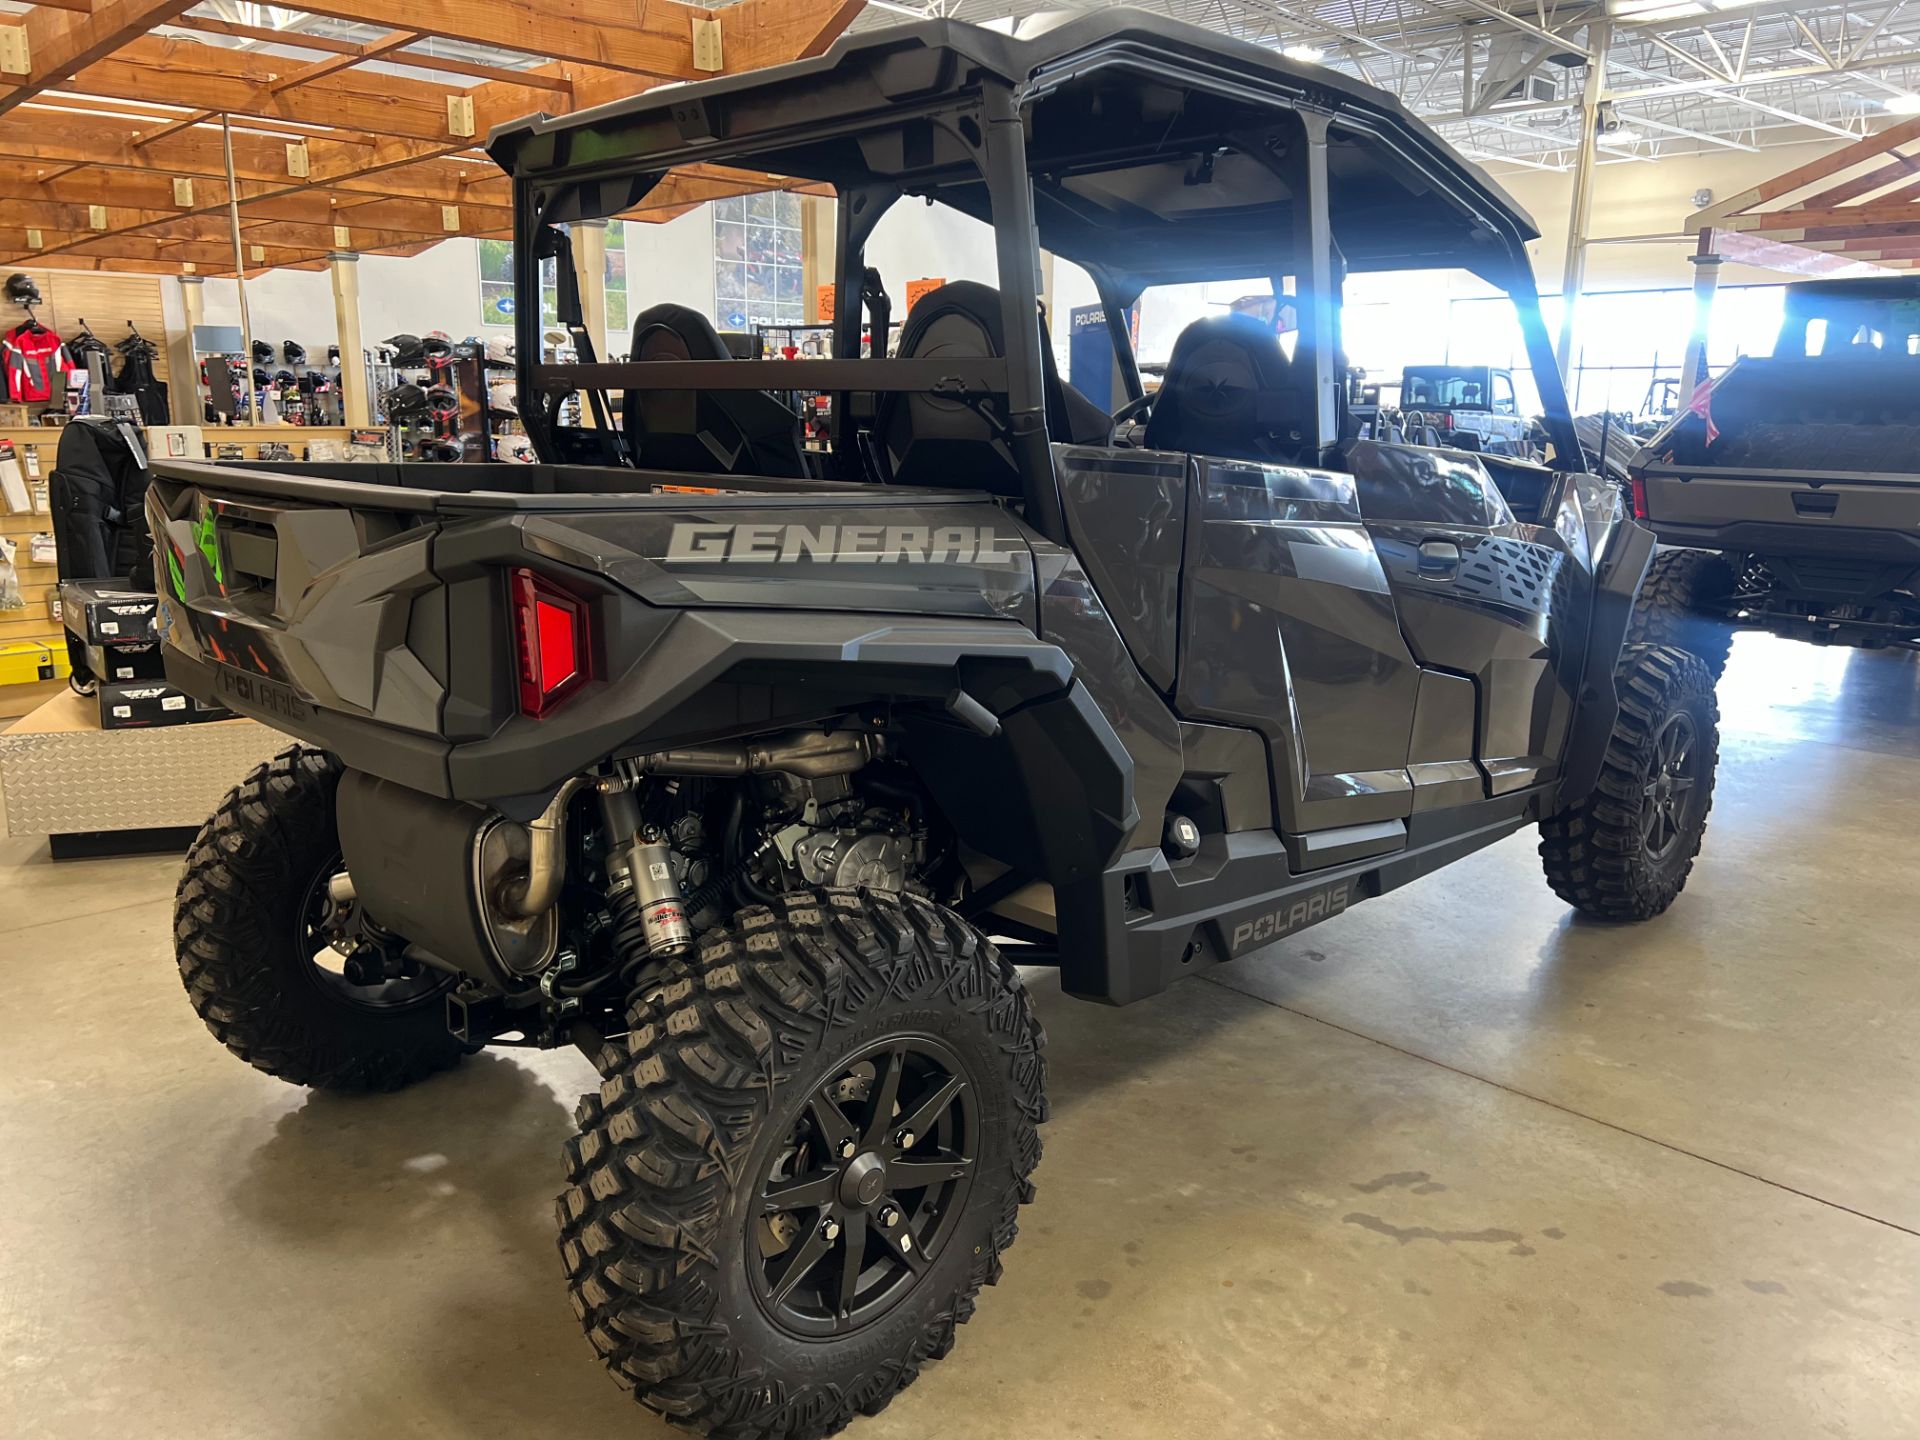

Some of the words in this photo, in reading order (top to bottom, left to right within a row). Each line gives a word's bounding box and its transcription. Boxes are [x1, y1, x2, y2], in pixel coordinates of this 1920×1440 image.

[1075, 311, 1107, 326] POLARIS
[664, 522, 1015, 564] GENERAL
[223, 669, 306, 721] POLARIS
[1232, 884, 1349, 951] POLARIS
